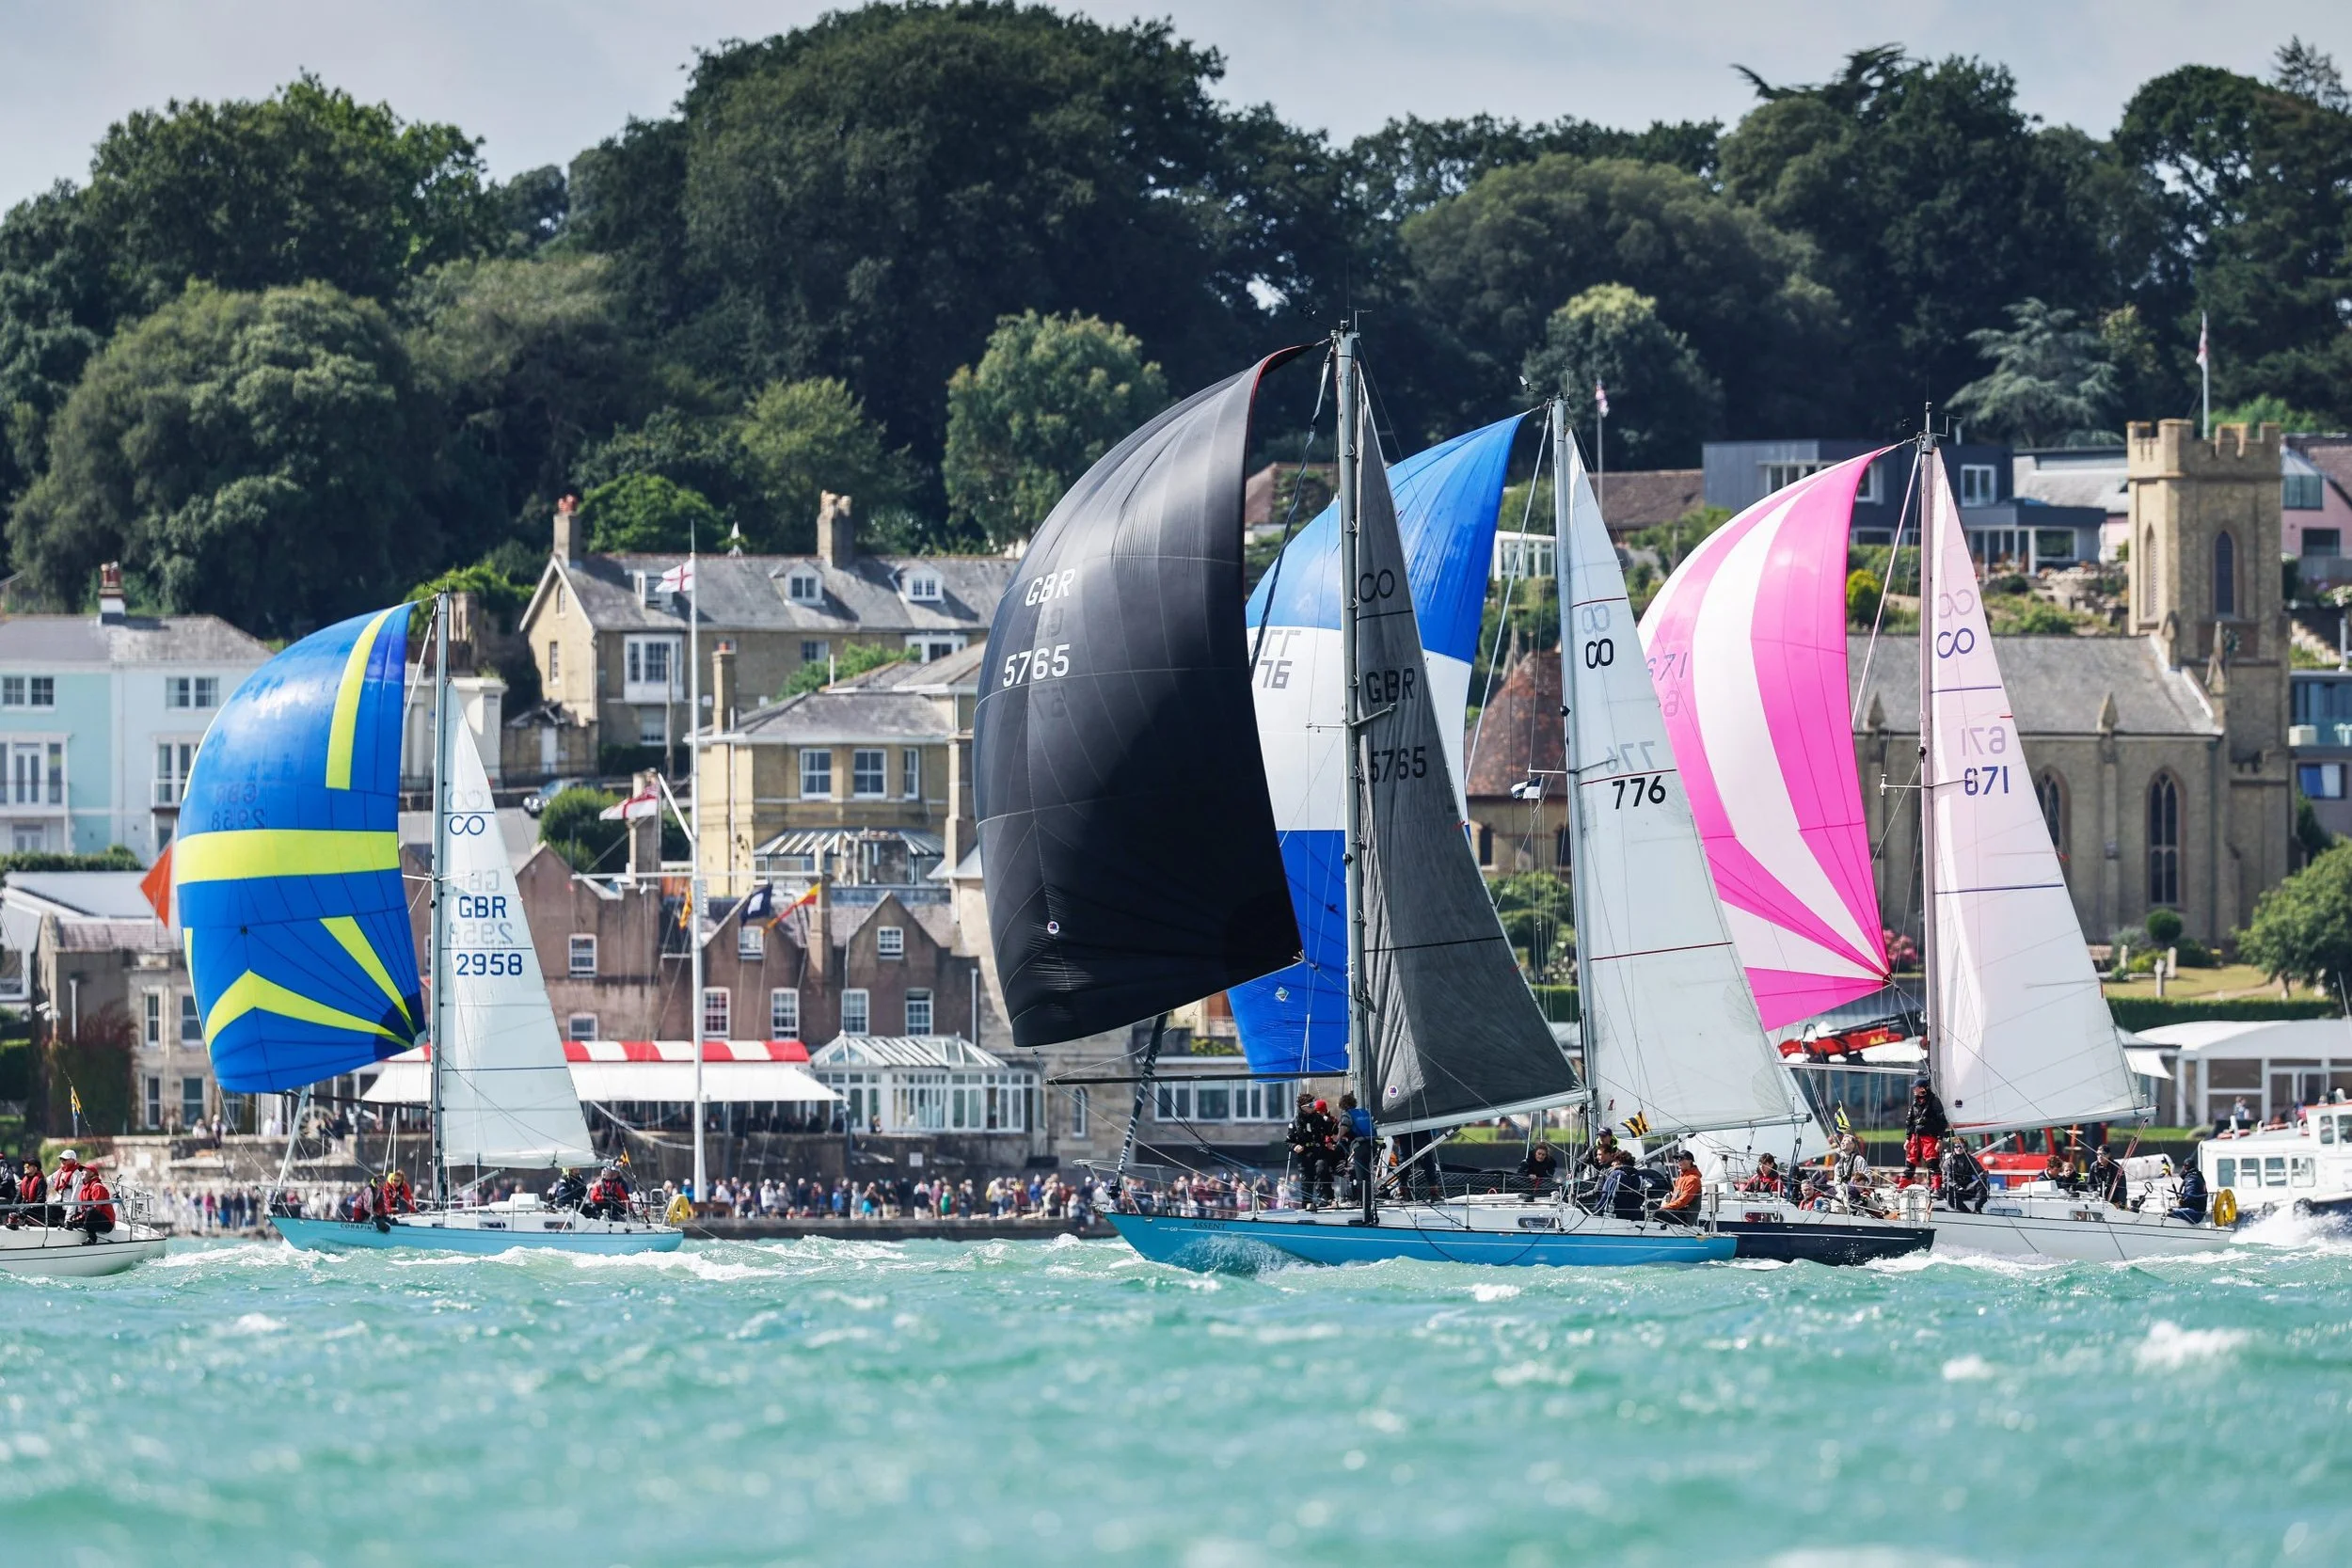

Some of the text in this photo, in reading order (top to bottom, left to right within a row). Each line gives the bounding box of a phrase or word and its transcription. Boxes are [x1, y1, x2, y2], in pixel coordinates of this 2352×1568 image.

[1025, 568, 1075, 607] GBR
[1003, 644, 1071, 688] 5765
[1366, 667, 1415, 704] GBR
[1371, 746, 1426, 784] 5765
[1964, 766, 2009, 796] 671
[1612, 775, 1666, 810] 776
[458, 895, 506, 919] GBR
[456, 953, 523, 976] 2958
[1191, 1222, 1227, 1230] ASSENT
